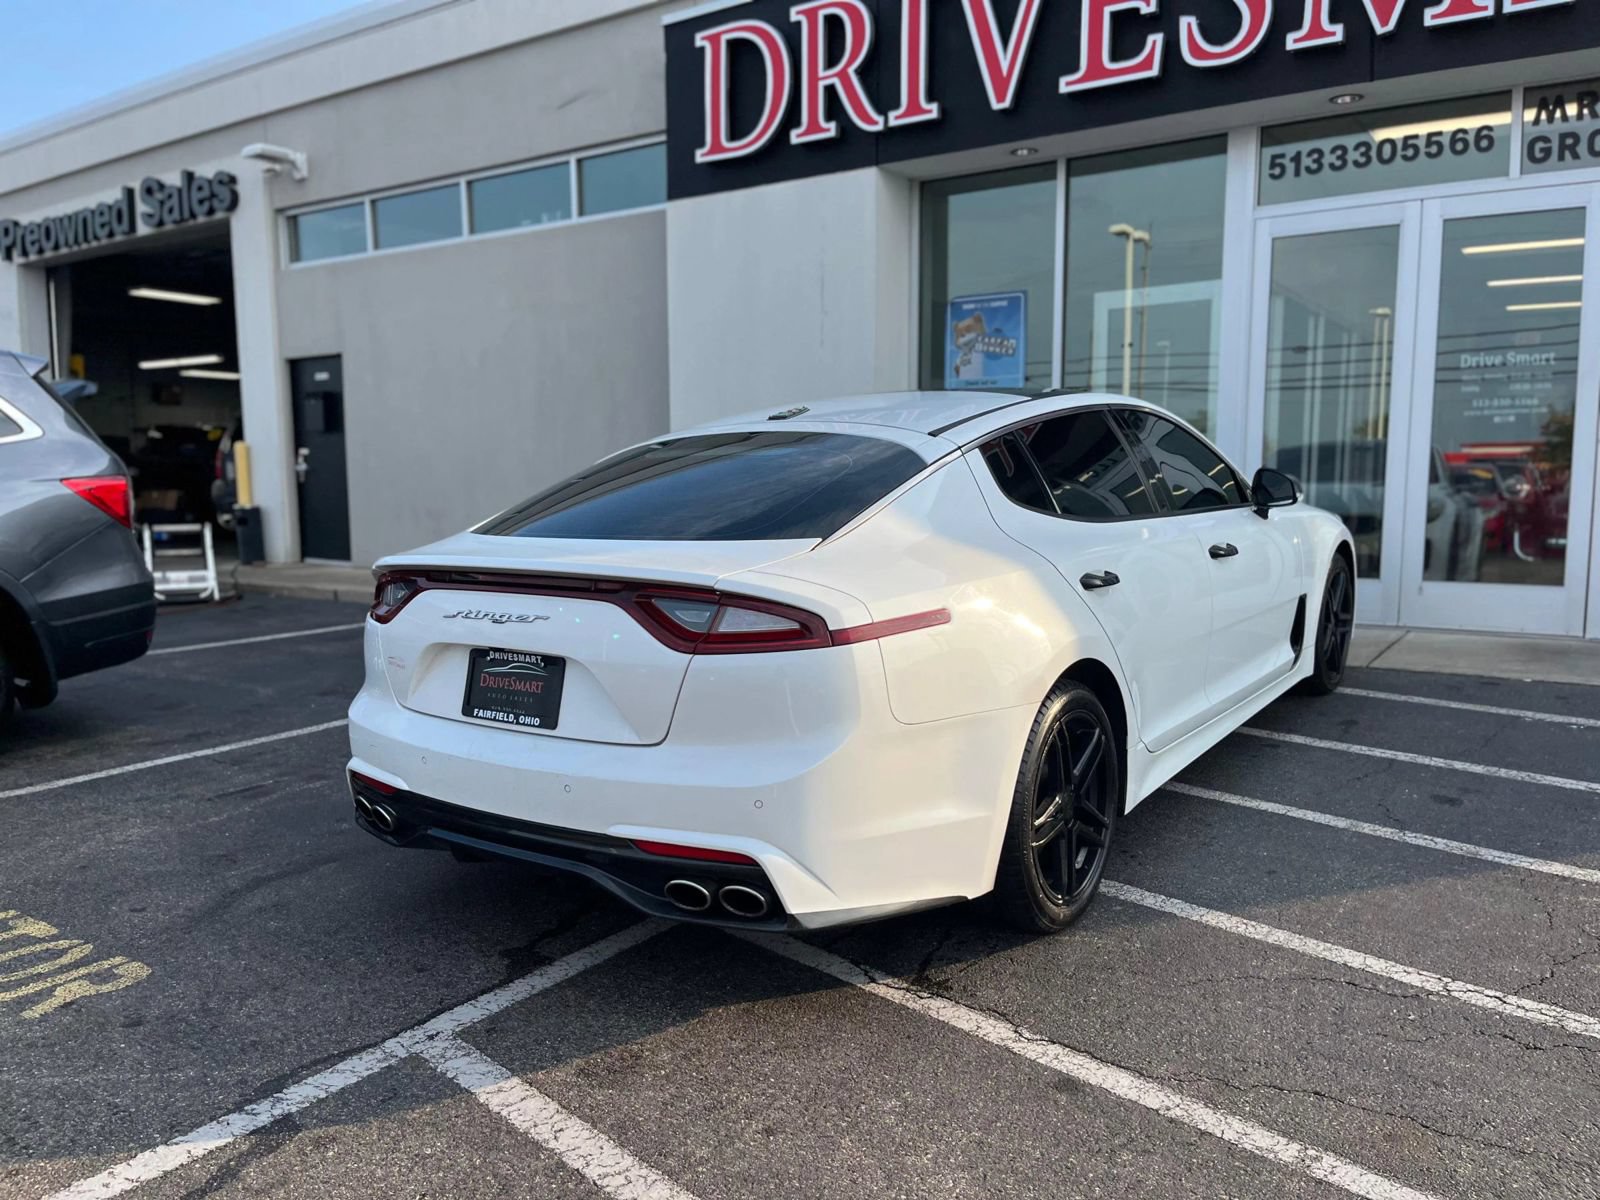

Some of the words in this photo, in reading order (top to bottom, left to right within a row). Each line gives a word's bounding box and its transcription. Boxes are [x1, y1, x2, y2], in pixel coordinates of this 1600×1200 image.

[695, 0, 1575, 163] DRIVES
[1268, 125, 1495, 180] 5133305566
[0, 185, 136, 261] Preowned
[141, 169, 239, 228] Sales
[1460, 352, 1504, 368] Drive
[1506, 351, 1556, 366] Smart
[489, 650, 542, 664] DRIVESMART
[473, 708, 517, 724] FAIRFIELD,
[519, 715, 540, 726] OHIO
